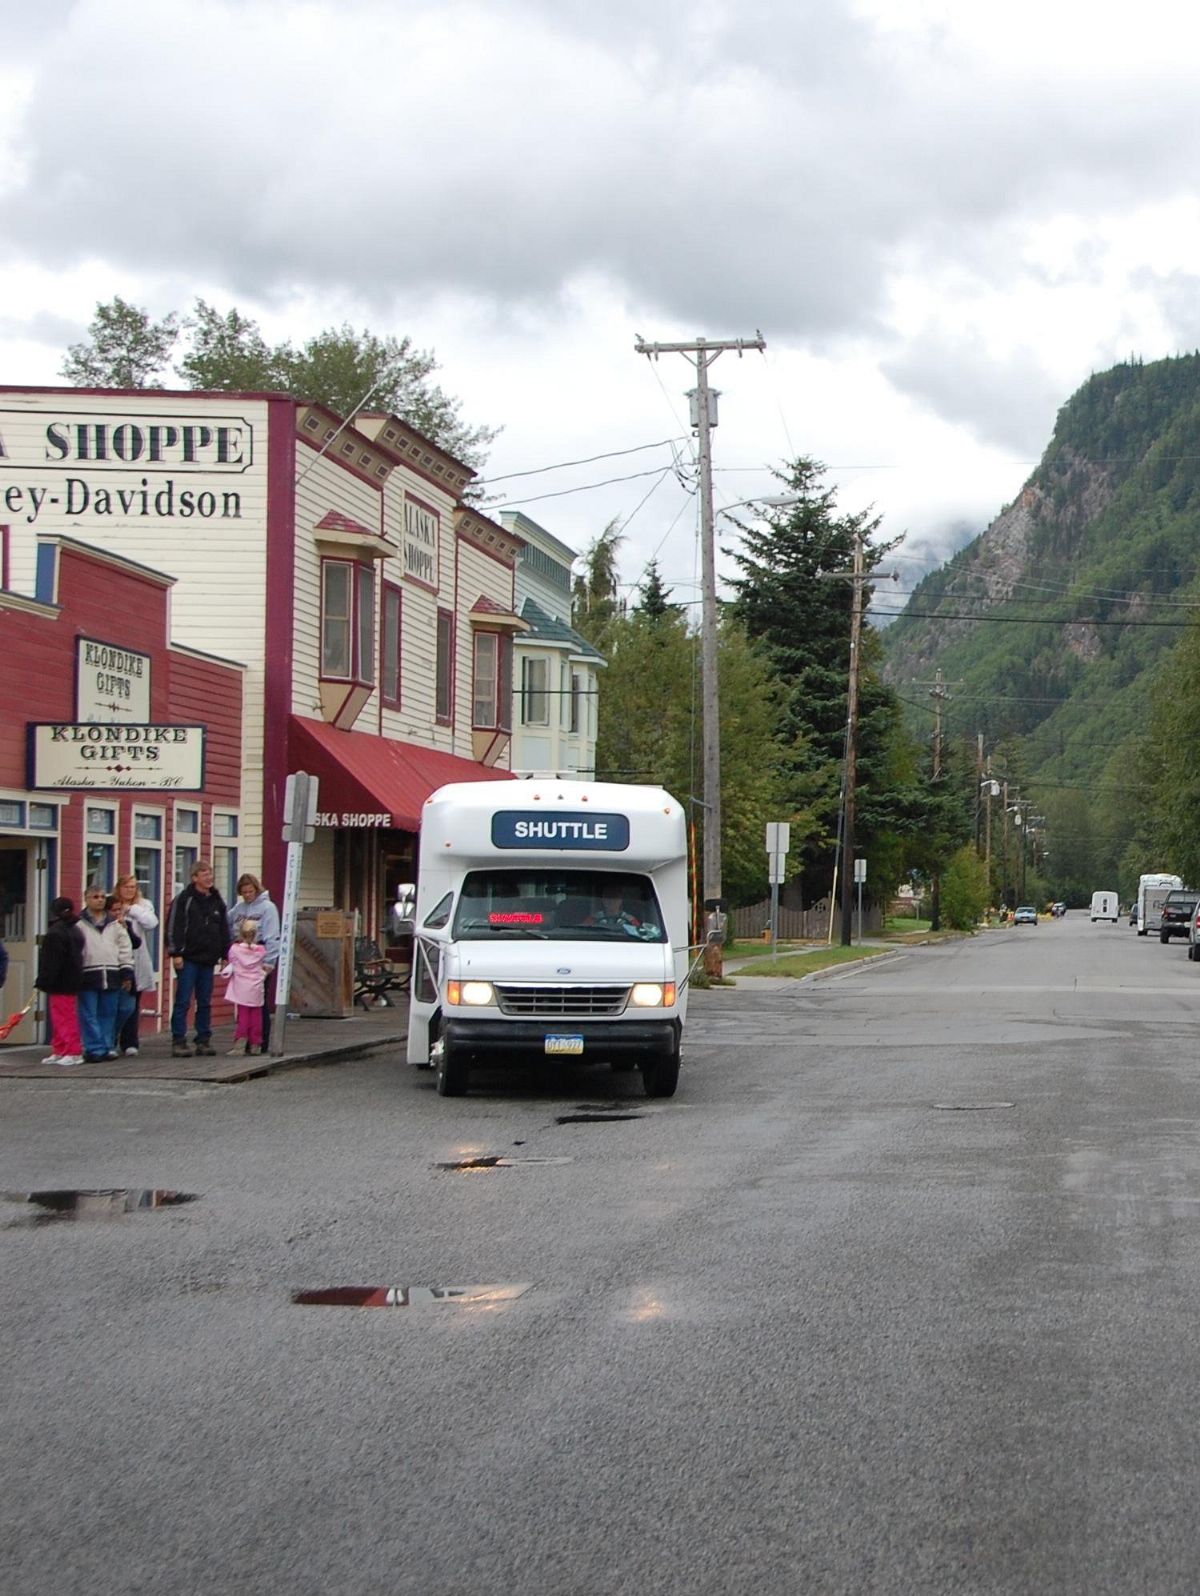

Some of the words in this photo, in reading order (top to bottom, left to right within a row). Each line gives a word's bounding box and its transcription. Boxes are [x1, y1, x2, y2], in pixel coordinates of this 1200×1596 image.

[45, 422, 244, 464] SHOPPE
[404, 503, 435, 548] ALASKA
[404, 543, 434, 583] SHOPPE
[85, 643, 144, 678] KLONDIKE
[96, 671, 131, 699] GIFTS
[51, 726, 188, 744] KLONDIKE
[79, 745, 160, 761] GIFTS
[52, 775, 96, 787] Alaska
[109, 775, 146, 787] Yukon
[314, 812, 339, 826] SKA
[341, 813, 392, 827] SHOPPE
[514, 821, 608, 840] SHUTTLE
